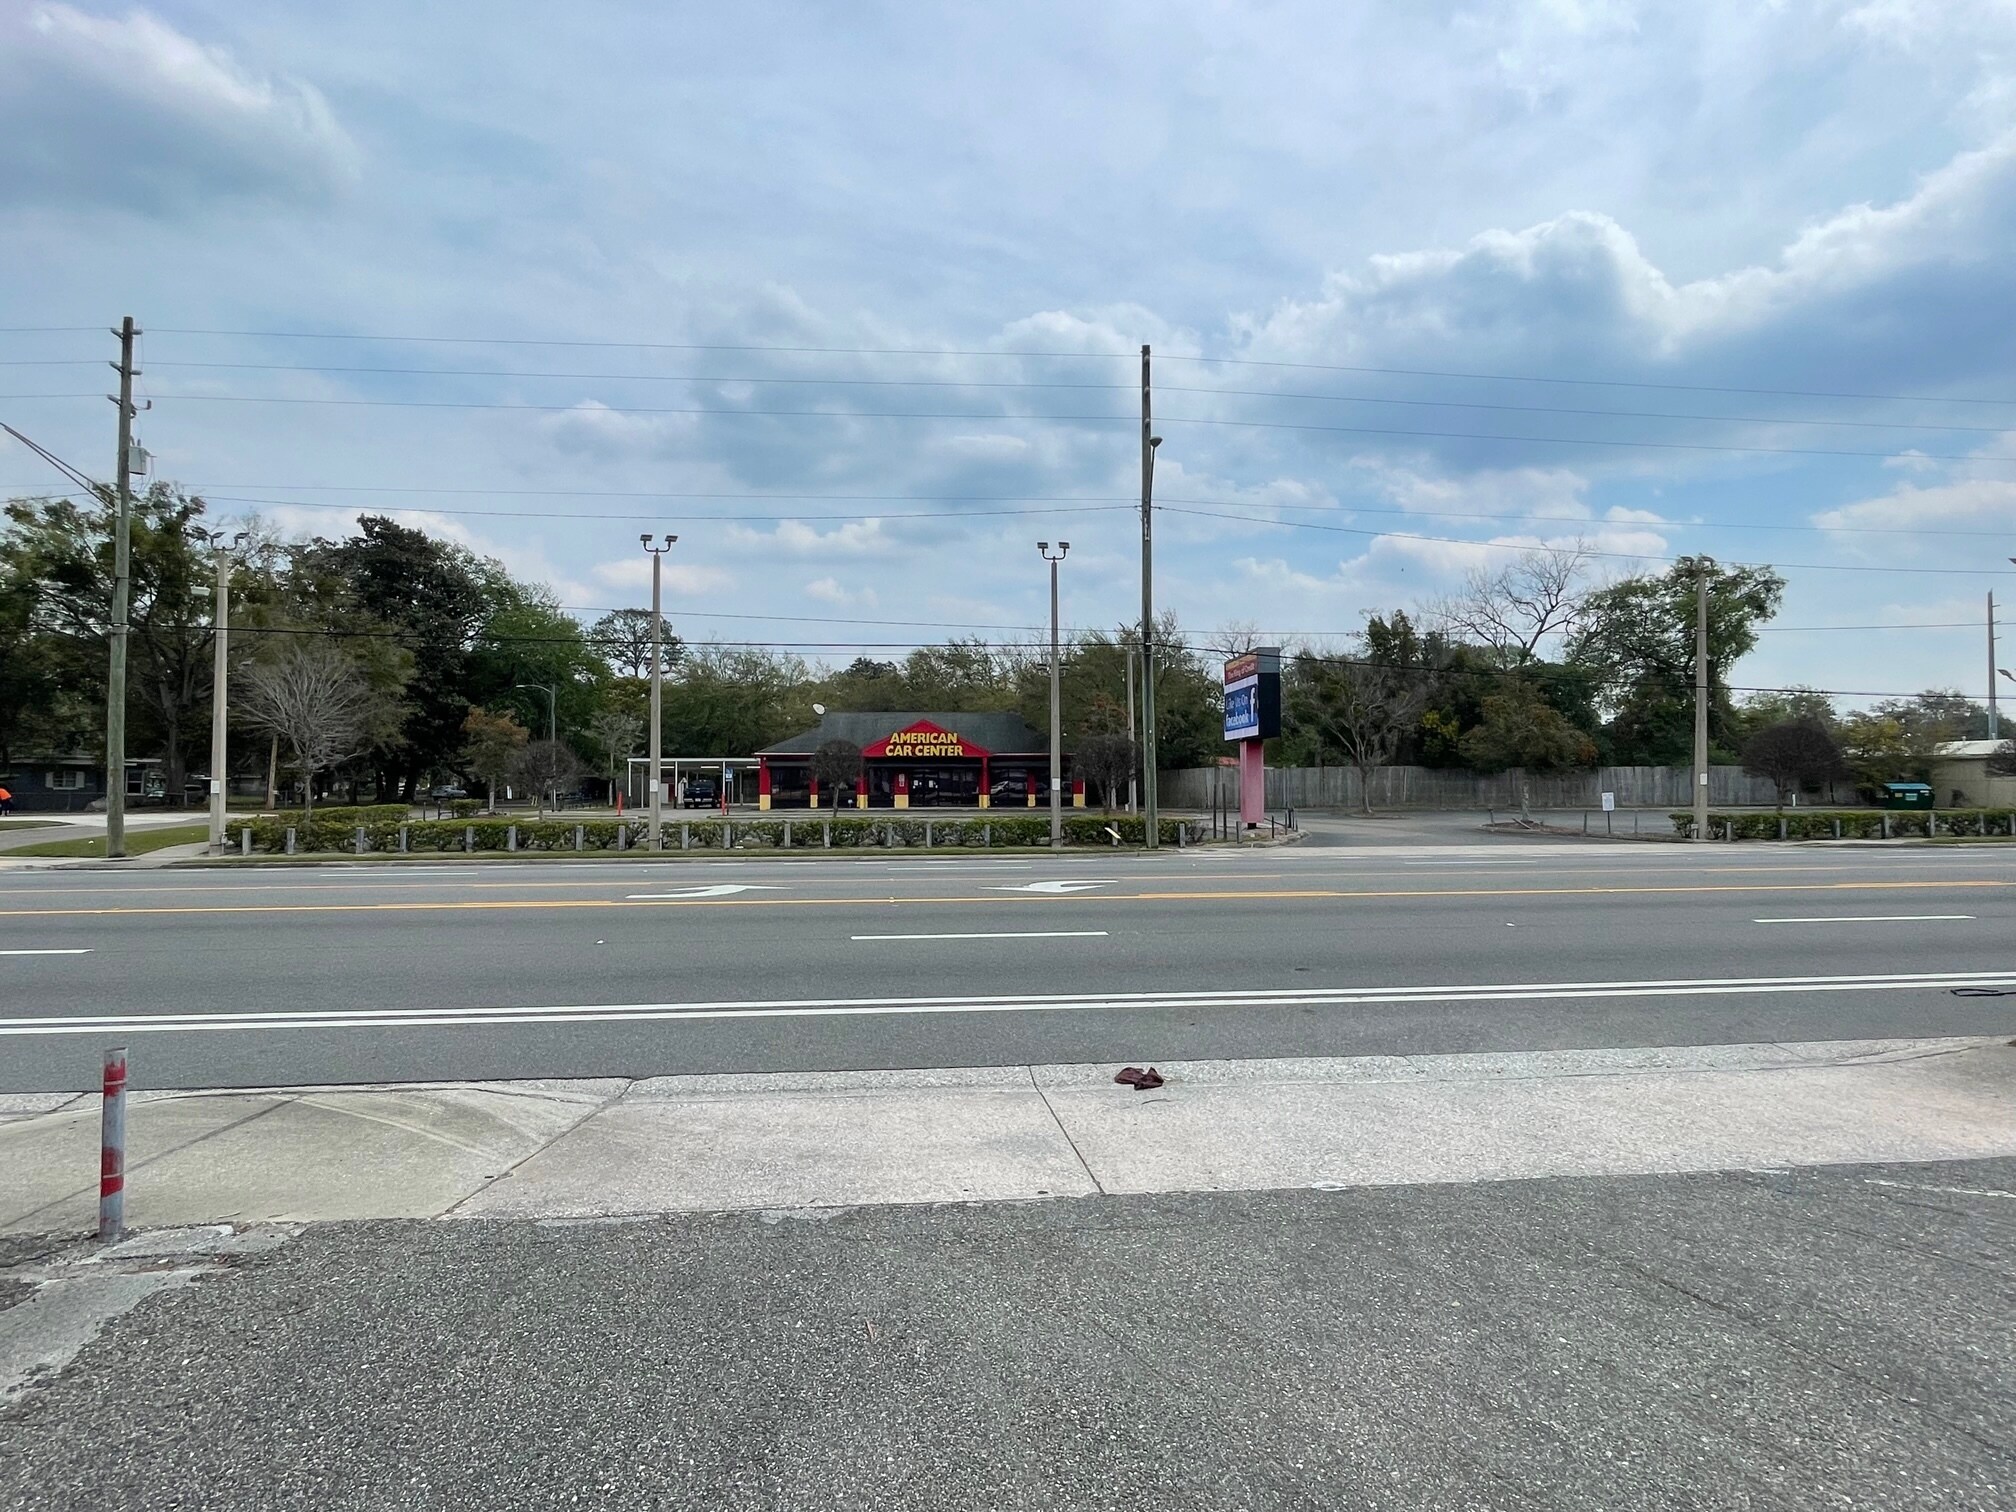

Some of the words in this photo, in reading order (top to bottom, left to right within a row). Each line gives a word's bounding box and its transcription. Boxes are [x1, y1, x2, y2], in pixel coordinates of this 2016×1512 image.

[1226, 709, 1249, 727] facebook
[889, 732, 958, 744] AMERICAN
[885, 745, 912, 757] CAR
[914, 745, 963, 757] CENTER
